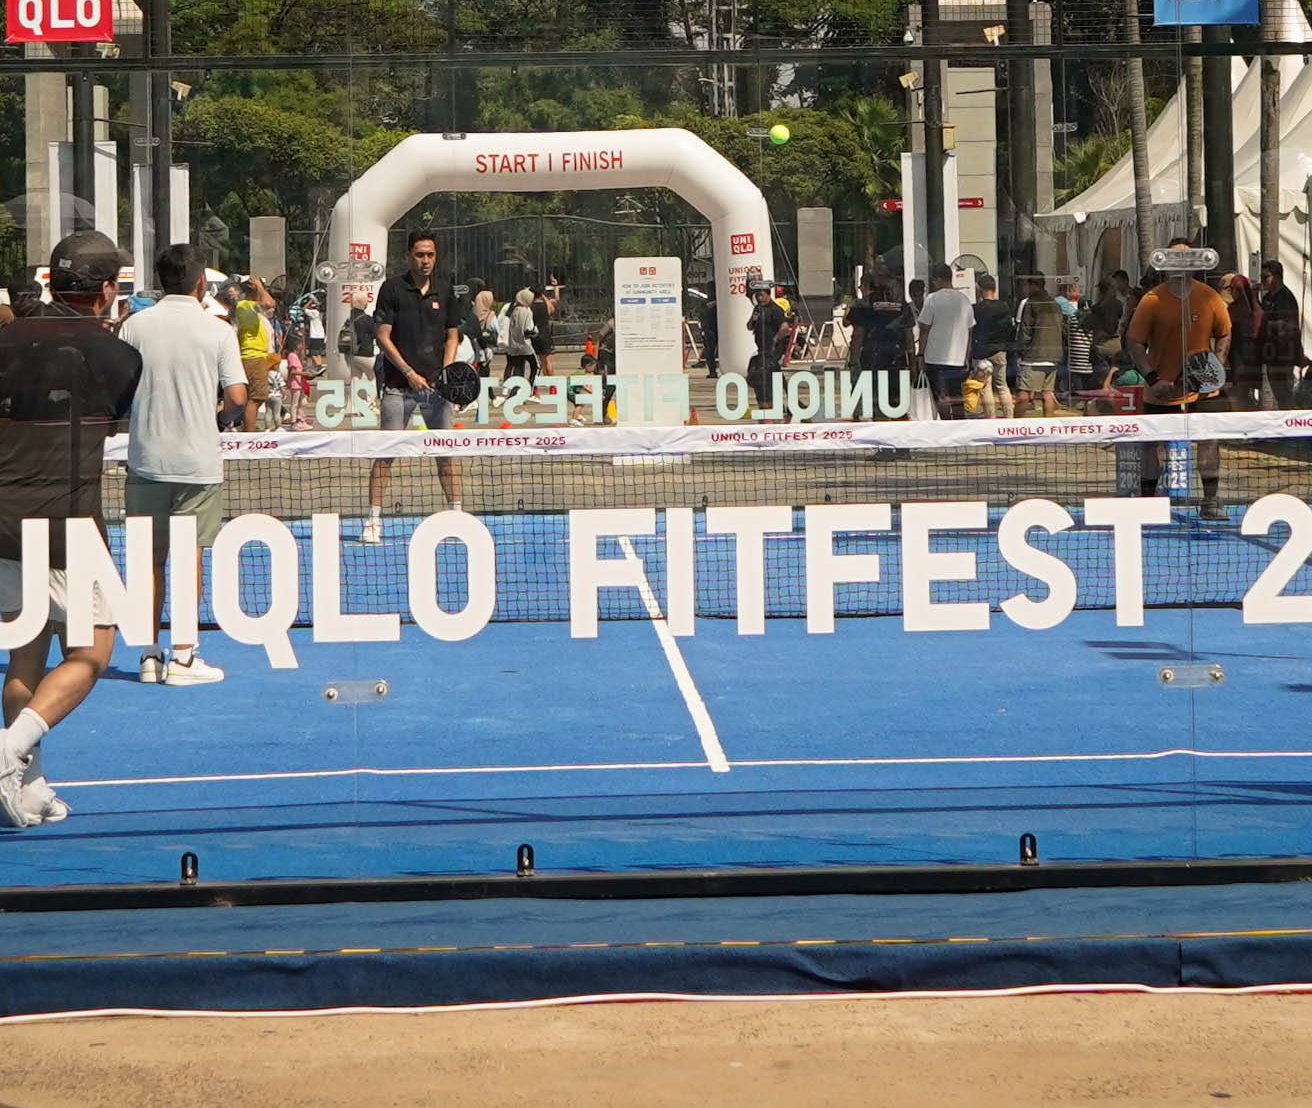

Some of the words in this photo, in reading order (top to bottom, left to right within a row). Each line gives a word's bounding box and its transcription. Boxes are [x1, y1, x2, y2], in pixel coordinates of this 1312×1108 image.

[475, 153, 539, 174] START
[562, 150, 623, 173] FINISH
[732, 235, 751, 244] UNI
[730, 283, 746, 295] 20
[341, 292, 374, 304] 25
[711, 432, 758, 442] UNIQLO
[764, 431, 817, 441] FITFEST
[823, 430, 854, 440] 2025
[997, 426, 1045, 437] UNIQLO
[1050, 424, 1103, 435] FITFEST
[1109, 423, 1139, 434] 2025
[248, 440, 279, 450] 2025
[423, 437, 471, 448] UNIQLO
[476, 436, 529, 447] FITFEST
[535, 435, 567, 446] 2025
[1119, 473, 1139, 490] 202
[569, 496, 1171, 640] FITFEST
